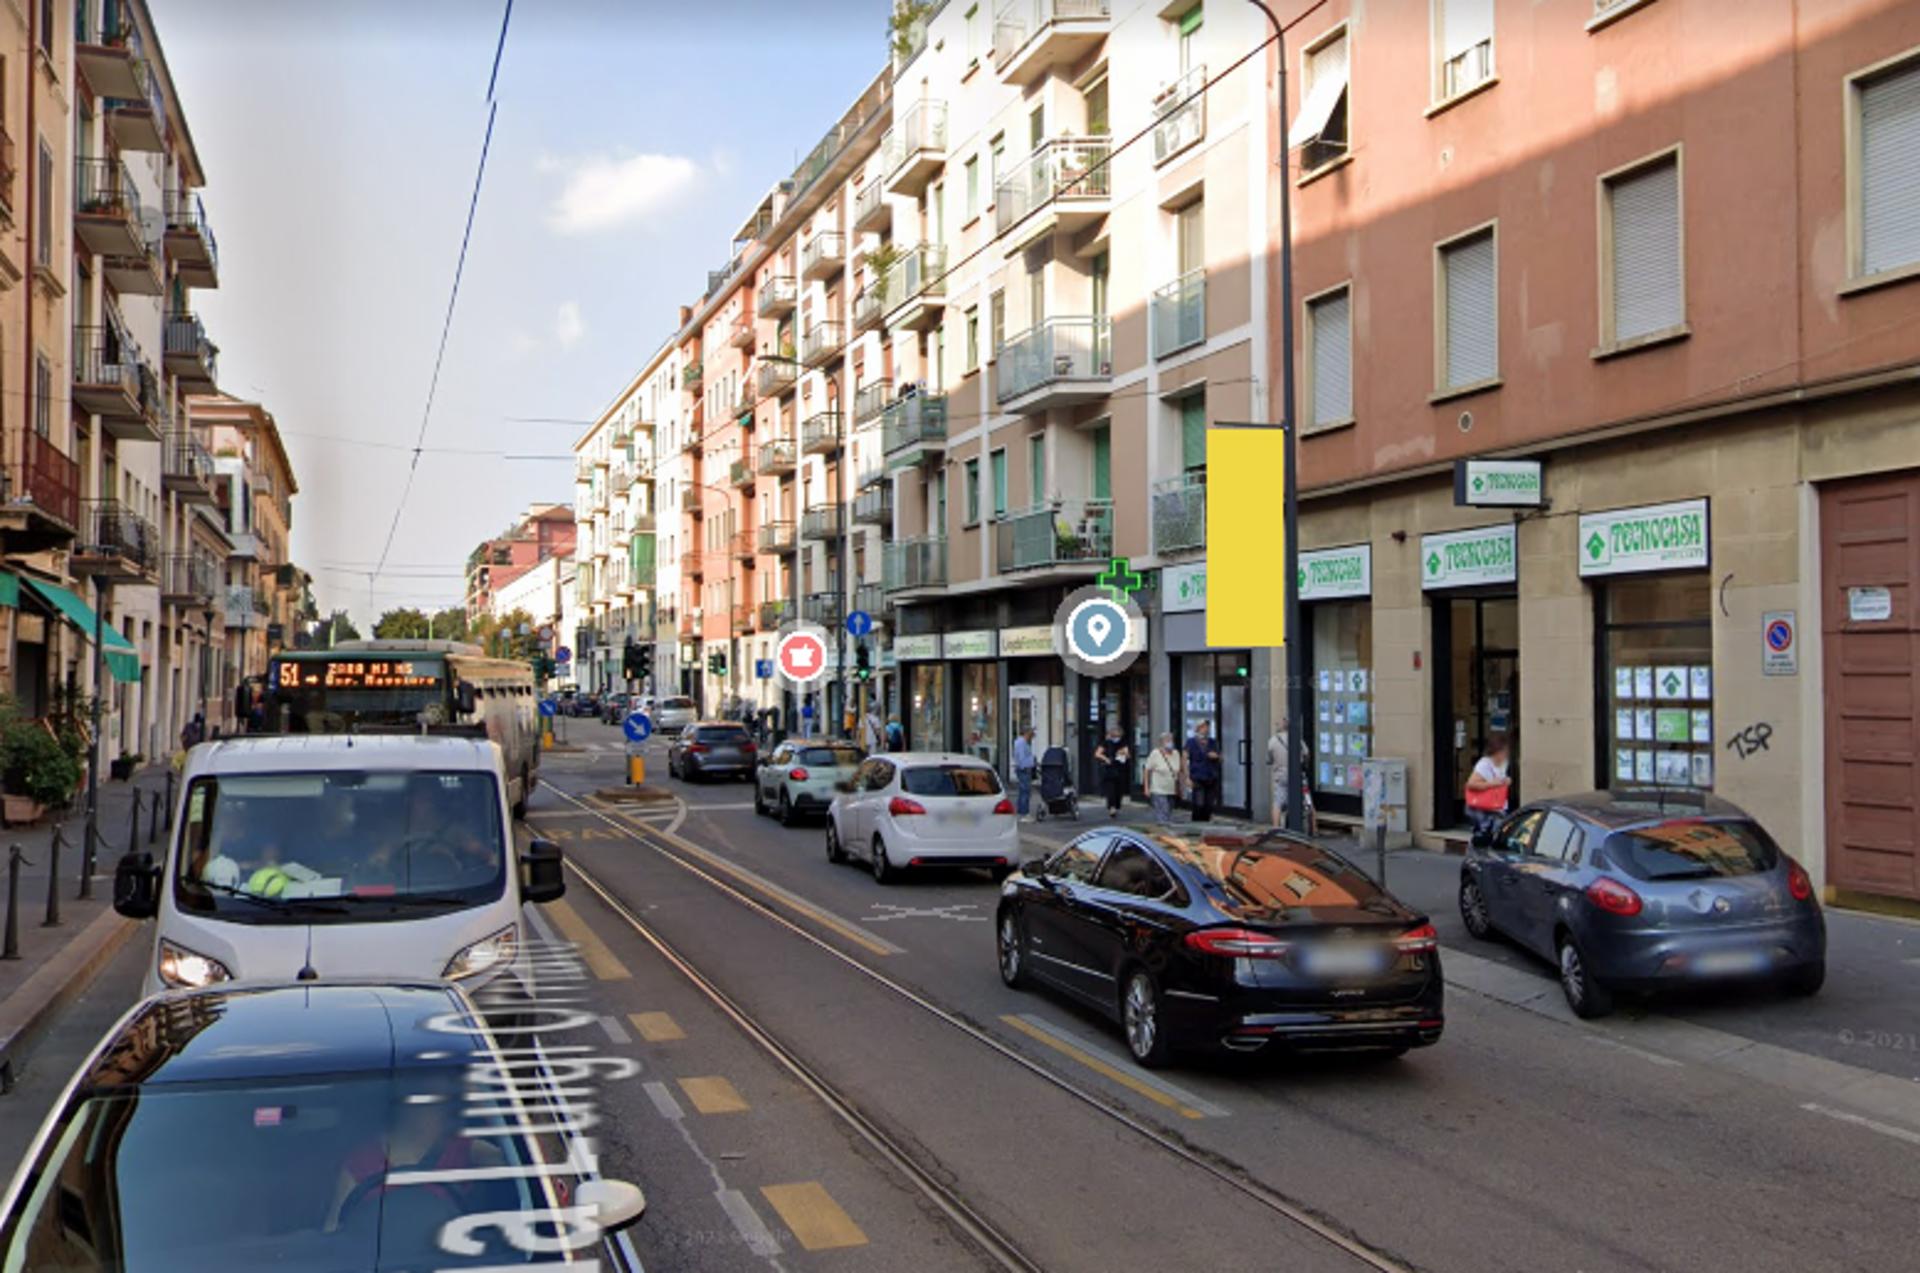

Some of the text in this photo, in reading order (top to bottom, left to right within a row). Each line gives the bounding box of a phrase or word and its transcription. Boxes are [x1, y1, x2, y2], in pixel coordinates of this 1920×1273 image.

[1609, 512, 1703, 554] TECNOCASA
[1444, 536, 1512, 571] TECNOCASA
[279, 663, 300, 687] 51
